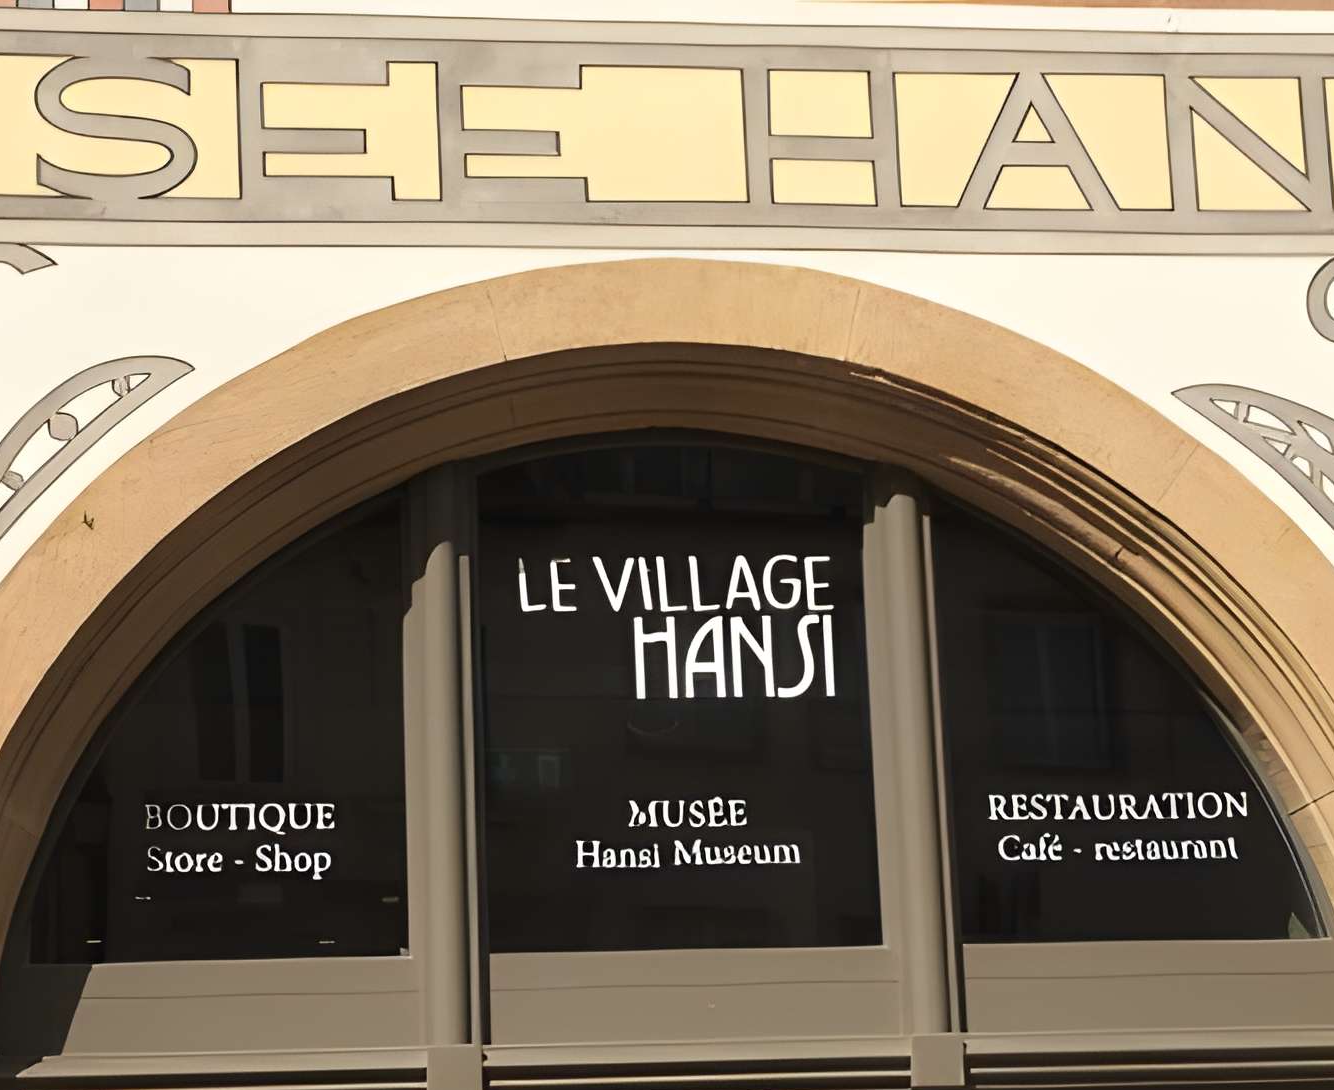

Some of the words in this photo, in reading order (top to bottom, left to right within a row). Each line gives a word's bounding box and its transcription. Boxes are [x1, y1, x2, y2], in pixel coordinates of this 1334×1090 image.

[518, 557, 577, 612] LE
[592, 554, 834, 612] VILLAGE
[633, 614, 835, 700] HANSI
[145, 803, 335, 835] BOUTIQUE
[988, 792, 1248, 820] RESTAURATION
[147, 846, 223, 872] Store
[255, 843, 332, 880] Shop
[575, 839, 660, 868] Hansi
[674, 839, 801, 866] Museum
[997, 833, 1063, 861] Café
[1094, 837, 1239, 861] restaurant
